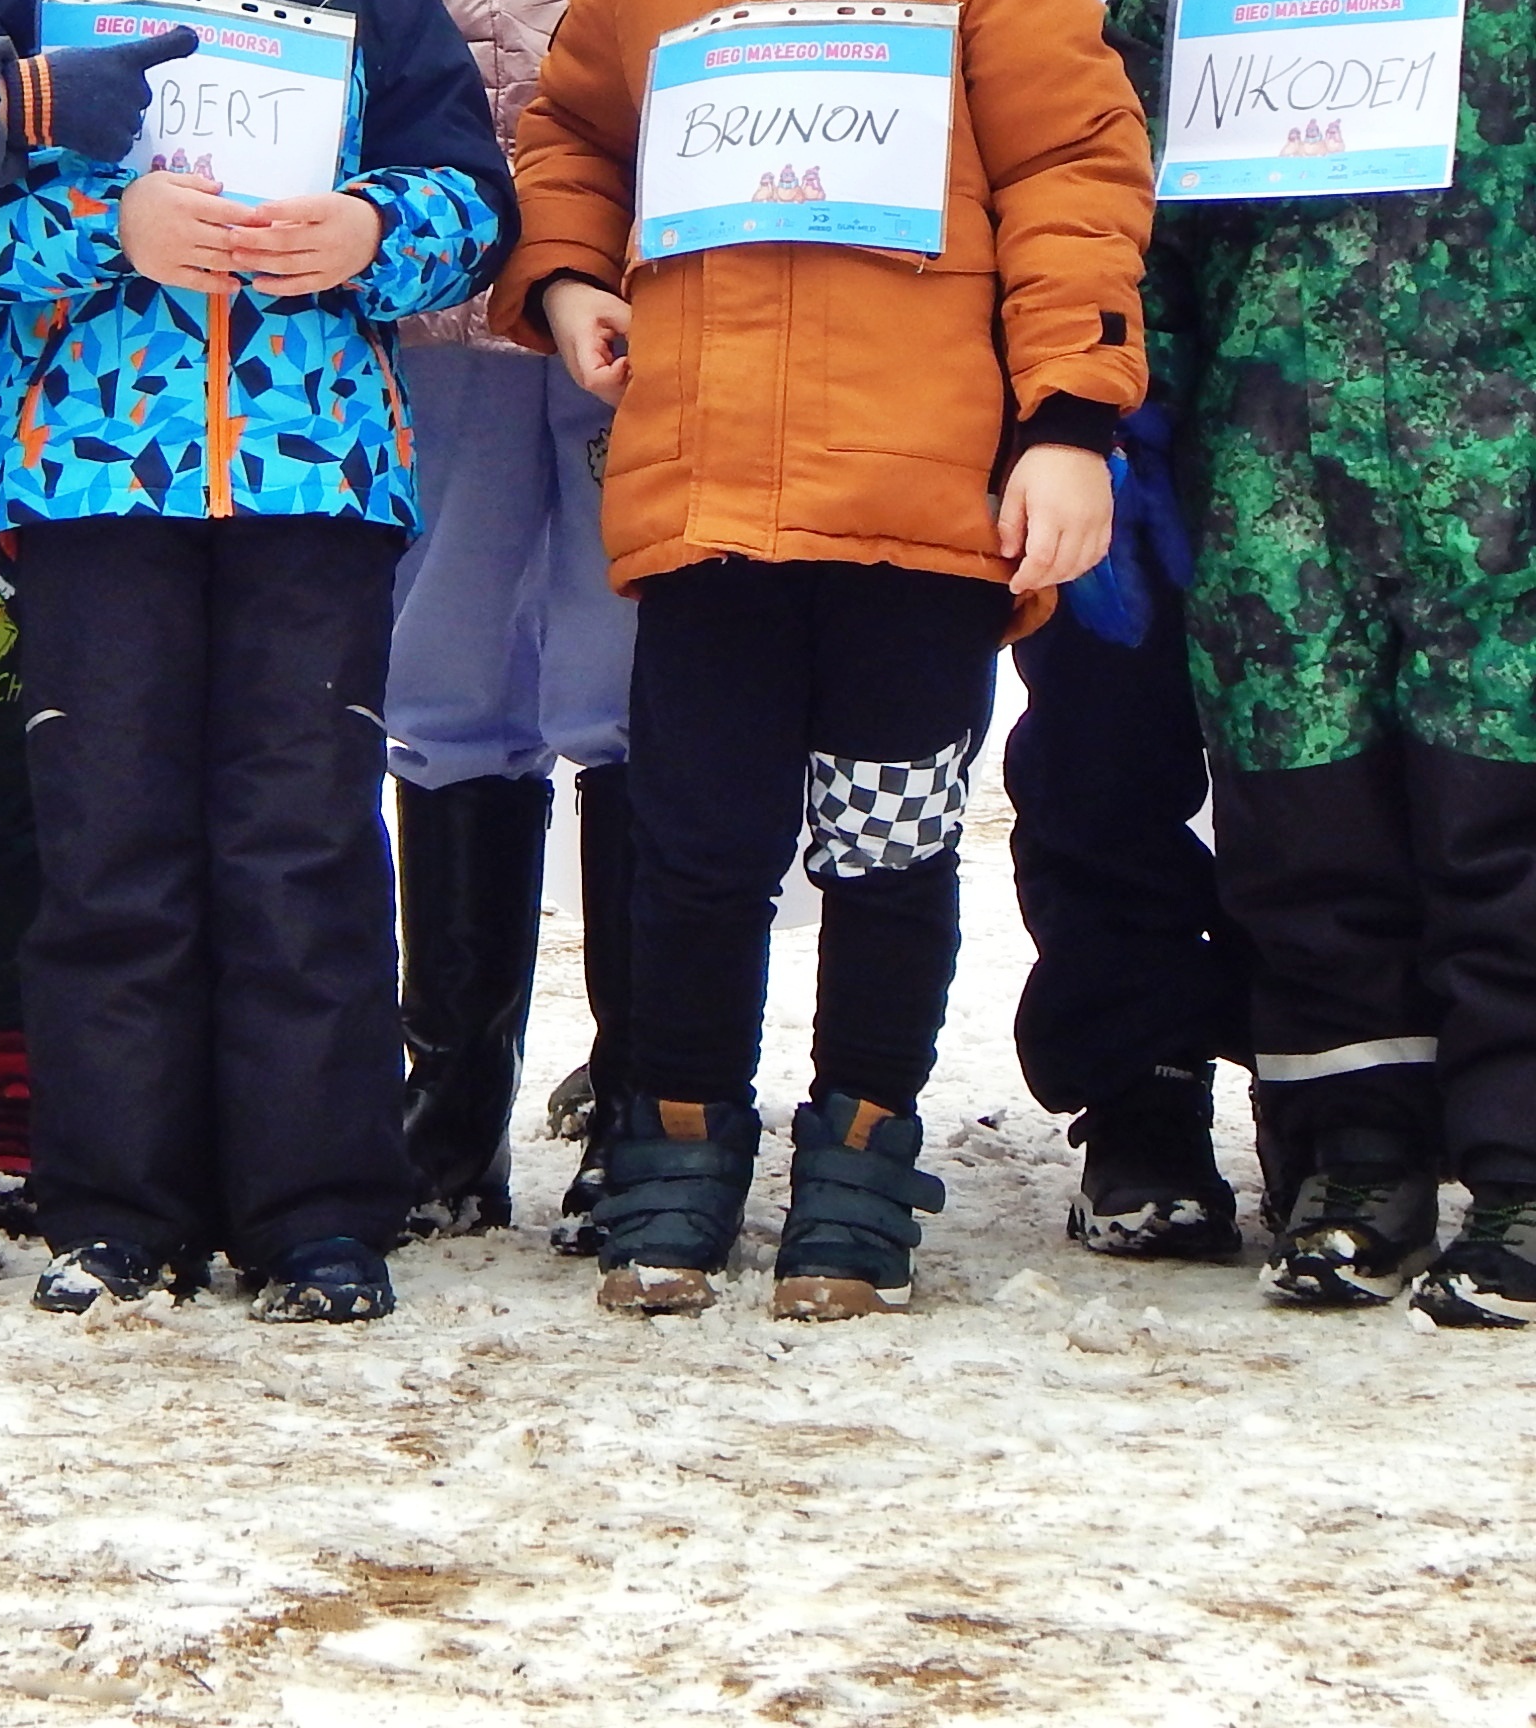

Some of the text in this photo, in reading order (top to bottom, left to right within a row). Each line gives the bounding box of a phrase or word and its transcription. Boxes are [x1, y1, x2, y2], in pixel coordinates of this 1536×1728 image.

[1233, 4, 1271, 24] BIEG
[96, 17, 136, 35] BIEG
[221, 28, 281, 56] MORSA
[705, 40, 890, 69] BIEG MAŁEGO MORSA
[1184, 50, 1437, 129] NIKODEM
[676, 101, 900, 158] BRUNON
